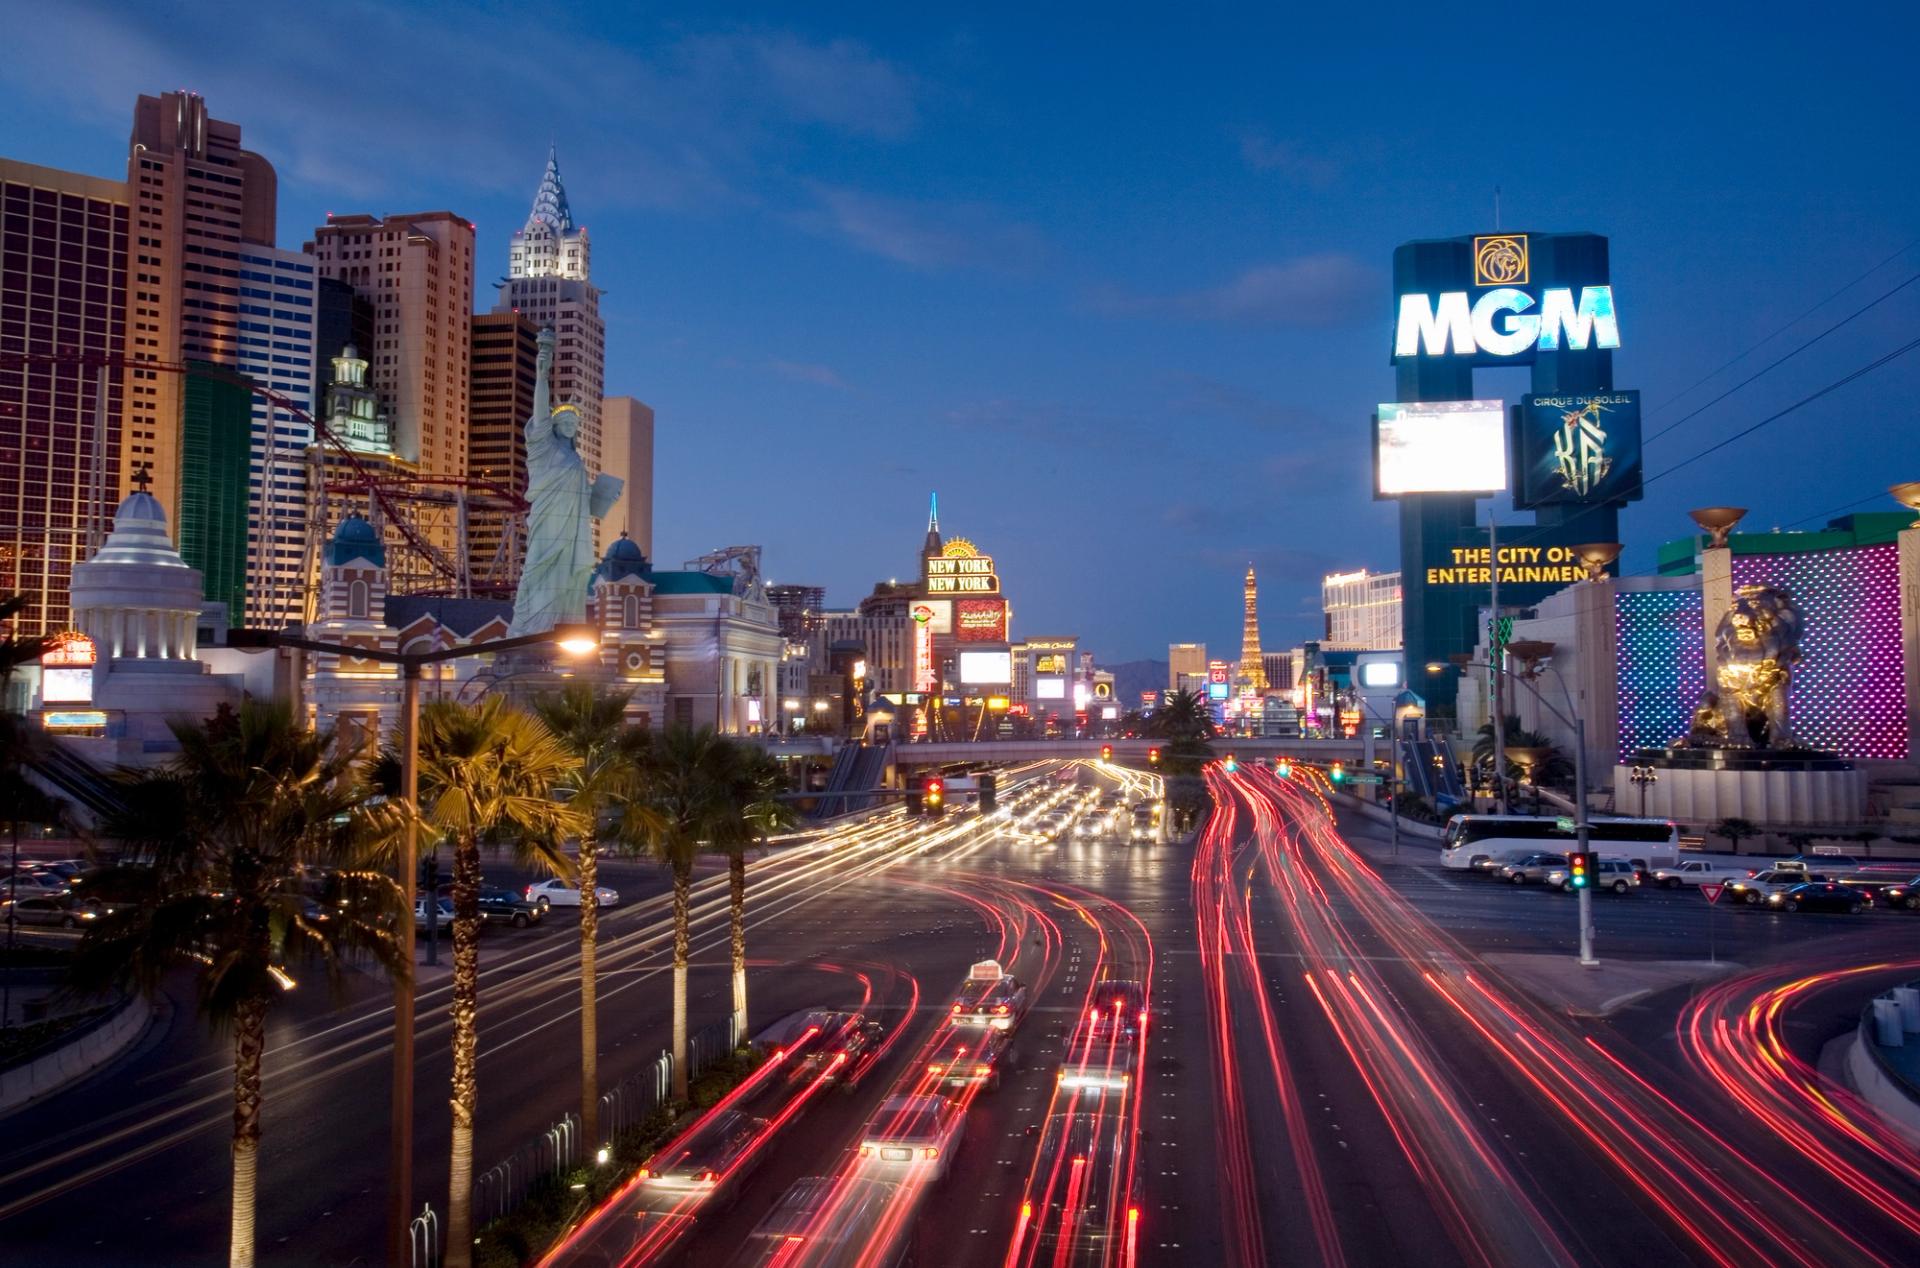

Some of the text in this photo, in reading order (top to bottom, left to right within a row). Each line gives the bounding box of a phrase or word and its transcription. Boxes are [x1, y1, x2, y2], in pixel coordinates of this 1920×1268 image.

[1396, 286, 1620, 356] MGM
[1534, 395, 1632, 408] CIRQUE DU SOLEIL
[1452, 548, 1491, 564] THE
[1497, 547, 1541, 564] CITY
[928, 559, 990, 574] NEW YORK
[1427, 566, 1589, 583] ENTERTAINMEN
[928, 577, 991, 591] NEW YORK
